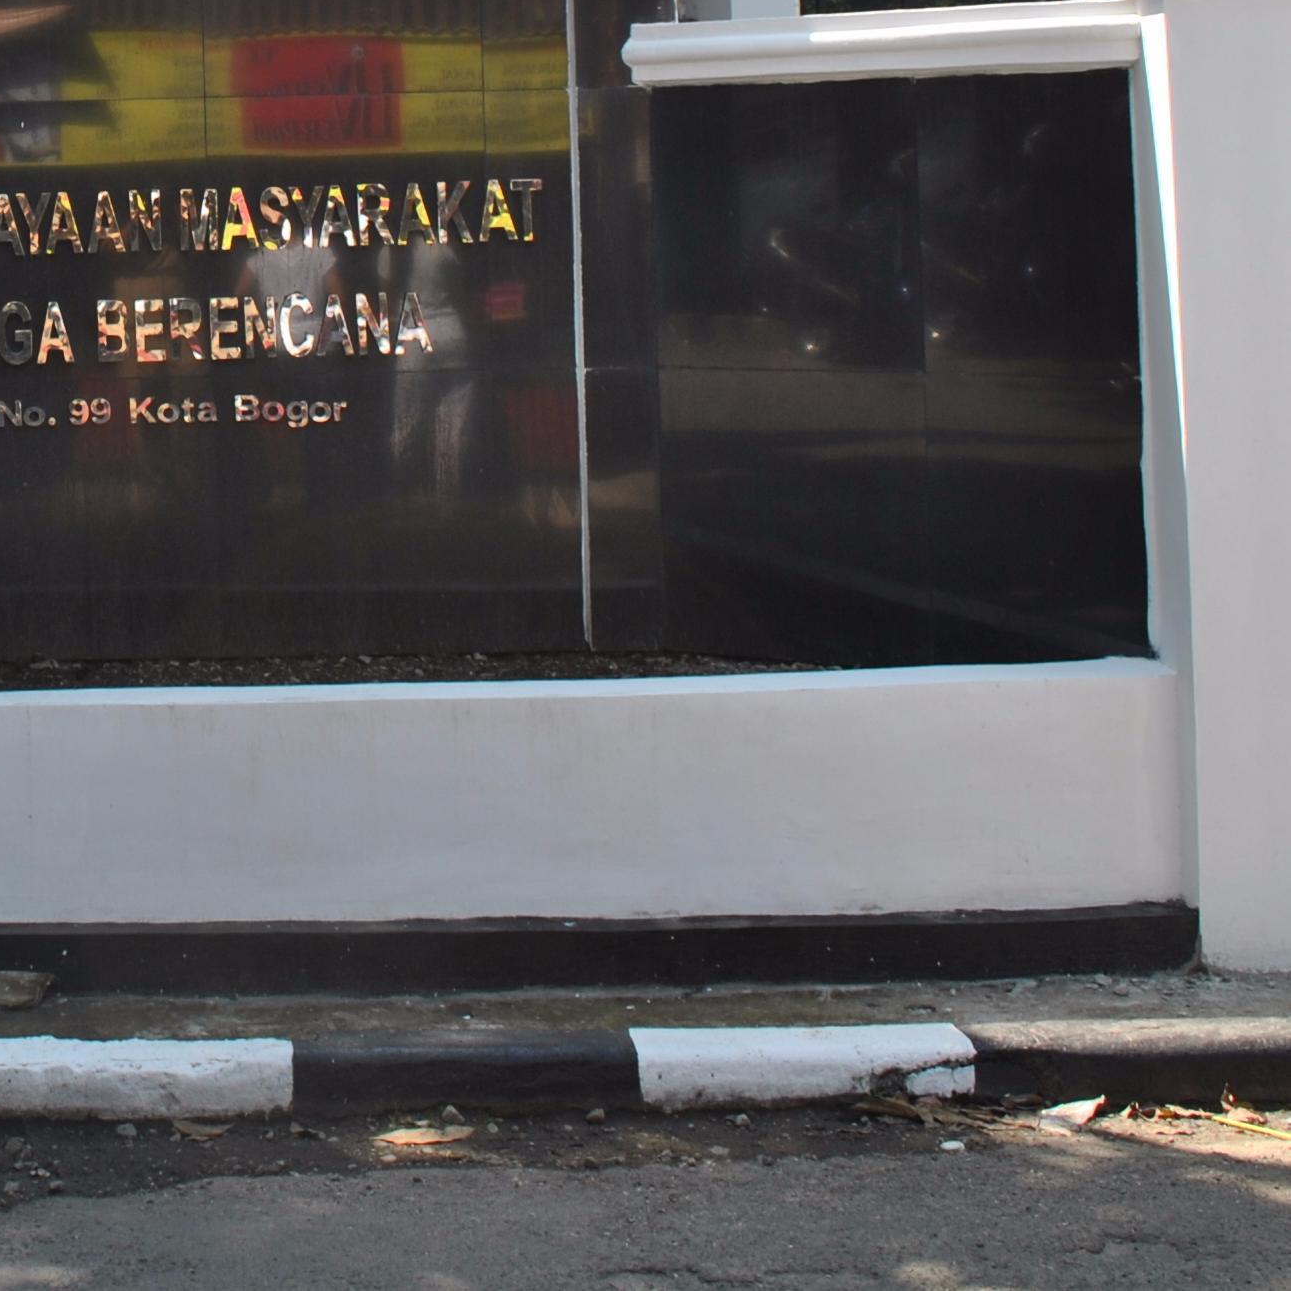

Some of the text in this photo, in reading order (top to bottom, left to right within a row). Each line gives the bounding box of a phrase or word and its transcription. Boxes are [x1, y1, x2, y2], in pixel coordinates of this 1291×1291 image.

[180, 177, 543, 252] MASYARAKAT
[96, 291, 434, 363] BERENCANA
[68, 397, 112, 424] 99
[128, 396, 218, 425] Kota
[234, 394, 348, 428] Bogor
